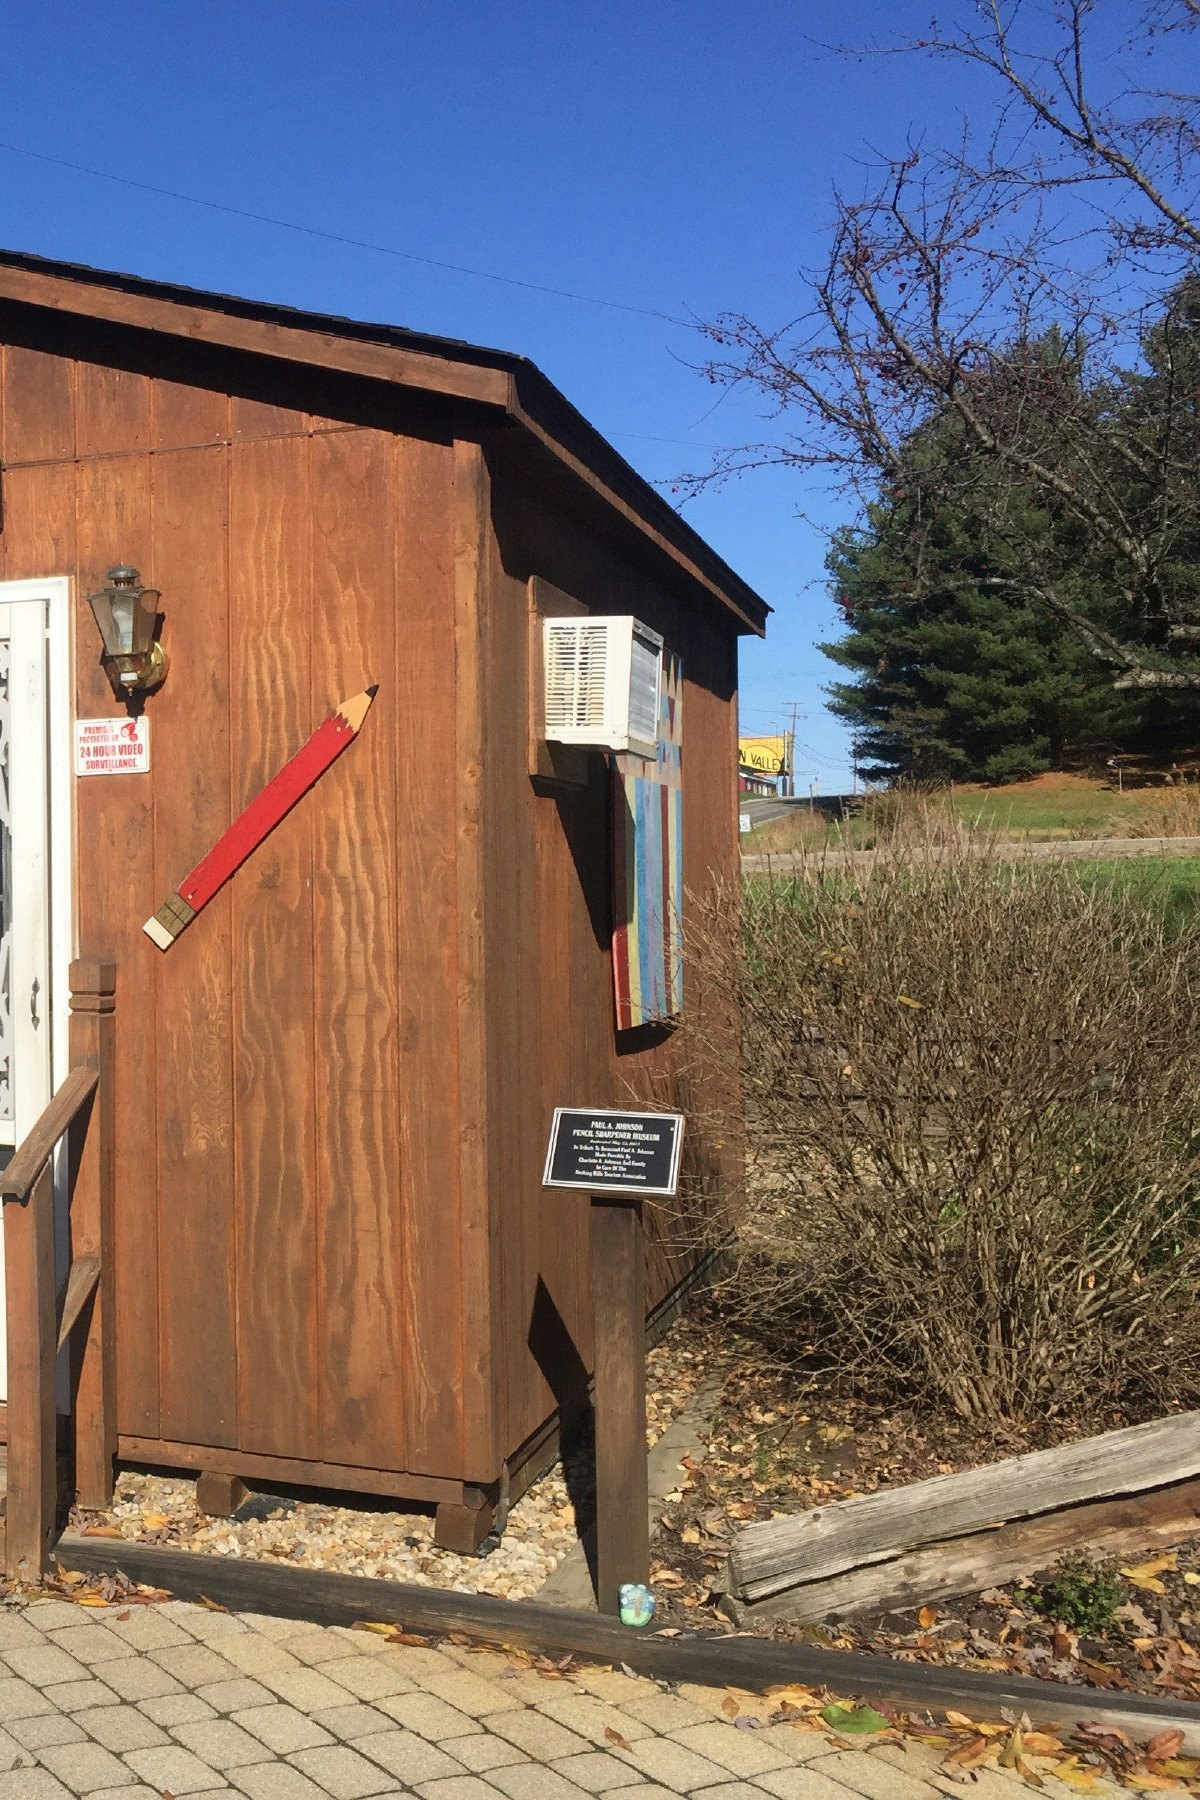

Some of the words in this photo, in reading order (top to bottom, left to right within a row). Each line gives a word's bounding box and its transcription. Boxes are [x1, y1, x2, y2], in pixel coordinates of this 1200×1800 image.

[80, 746, 91, 758] 24
[93, 745, 116, 757] HOUR
[118, 743, 143, 755] VIDEO
[85, 758, 138, 770] SURVEILLANCE
[590, 1121, 607, 1129] PAUL
[615, 1122, 644, 1131] JOHNSON
[572, 1129, 594, 1138] PENCIL
[595, 1130, 631, 1139] SHARPENER
[632, 1133, 660, 1141] MUSEUM
